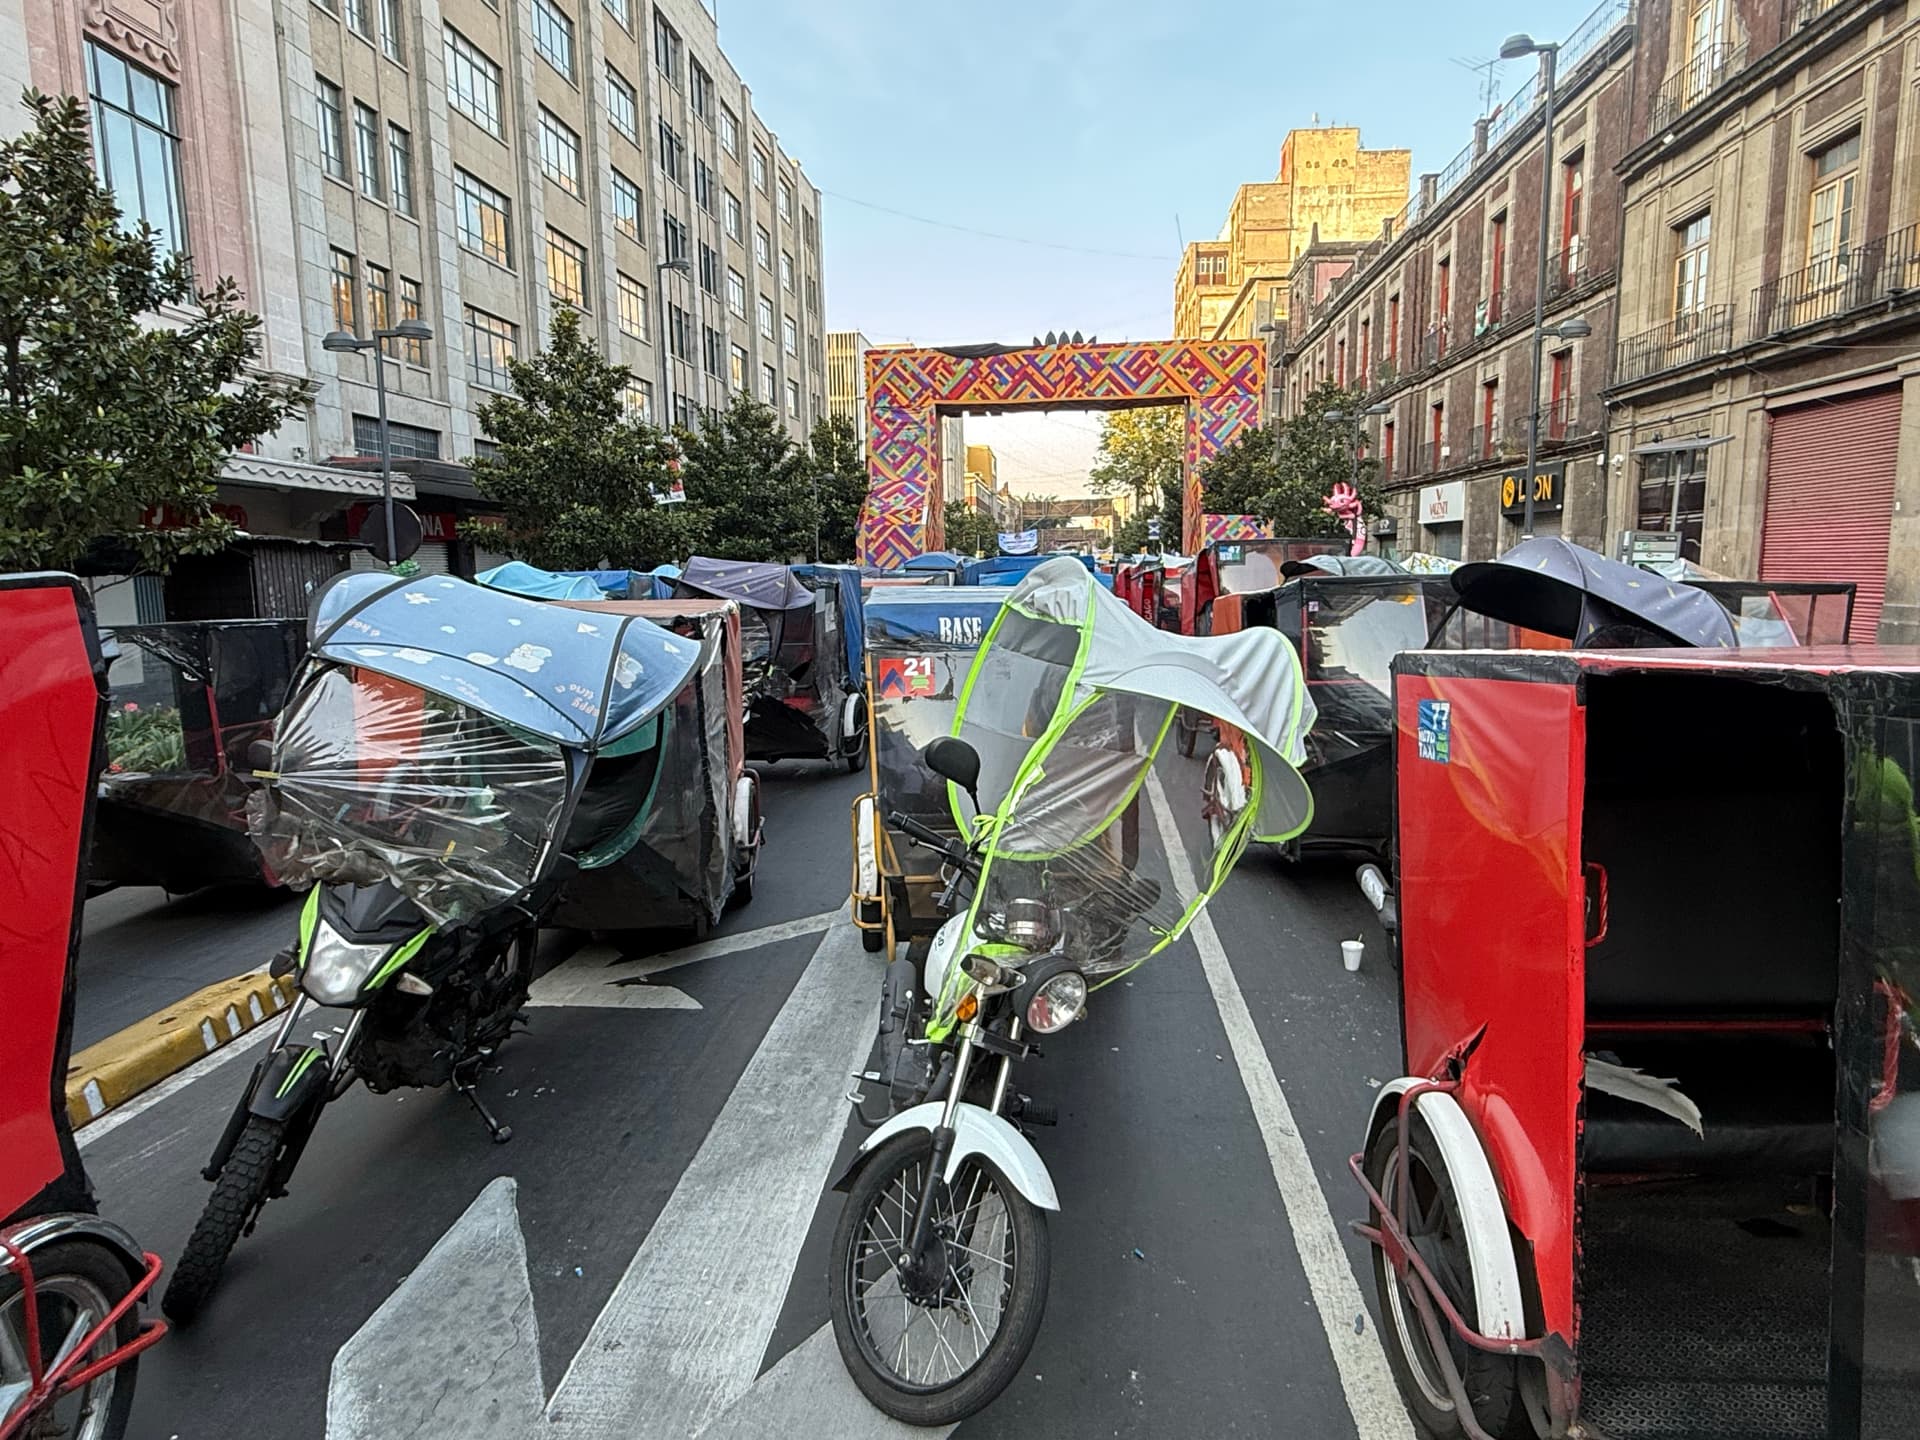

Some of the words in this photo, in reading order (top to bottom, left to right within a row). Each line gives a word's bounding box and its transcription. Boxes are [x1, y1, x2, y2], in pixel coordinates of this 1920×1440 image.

[1518, 474, 1552, 502] LON
[938, 616, 982, 644] BASE
[903, 657, 931, 676] 21
